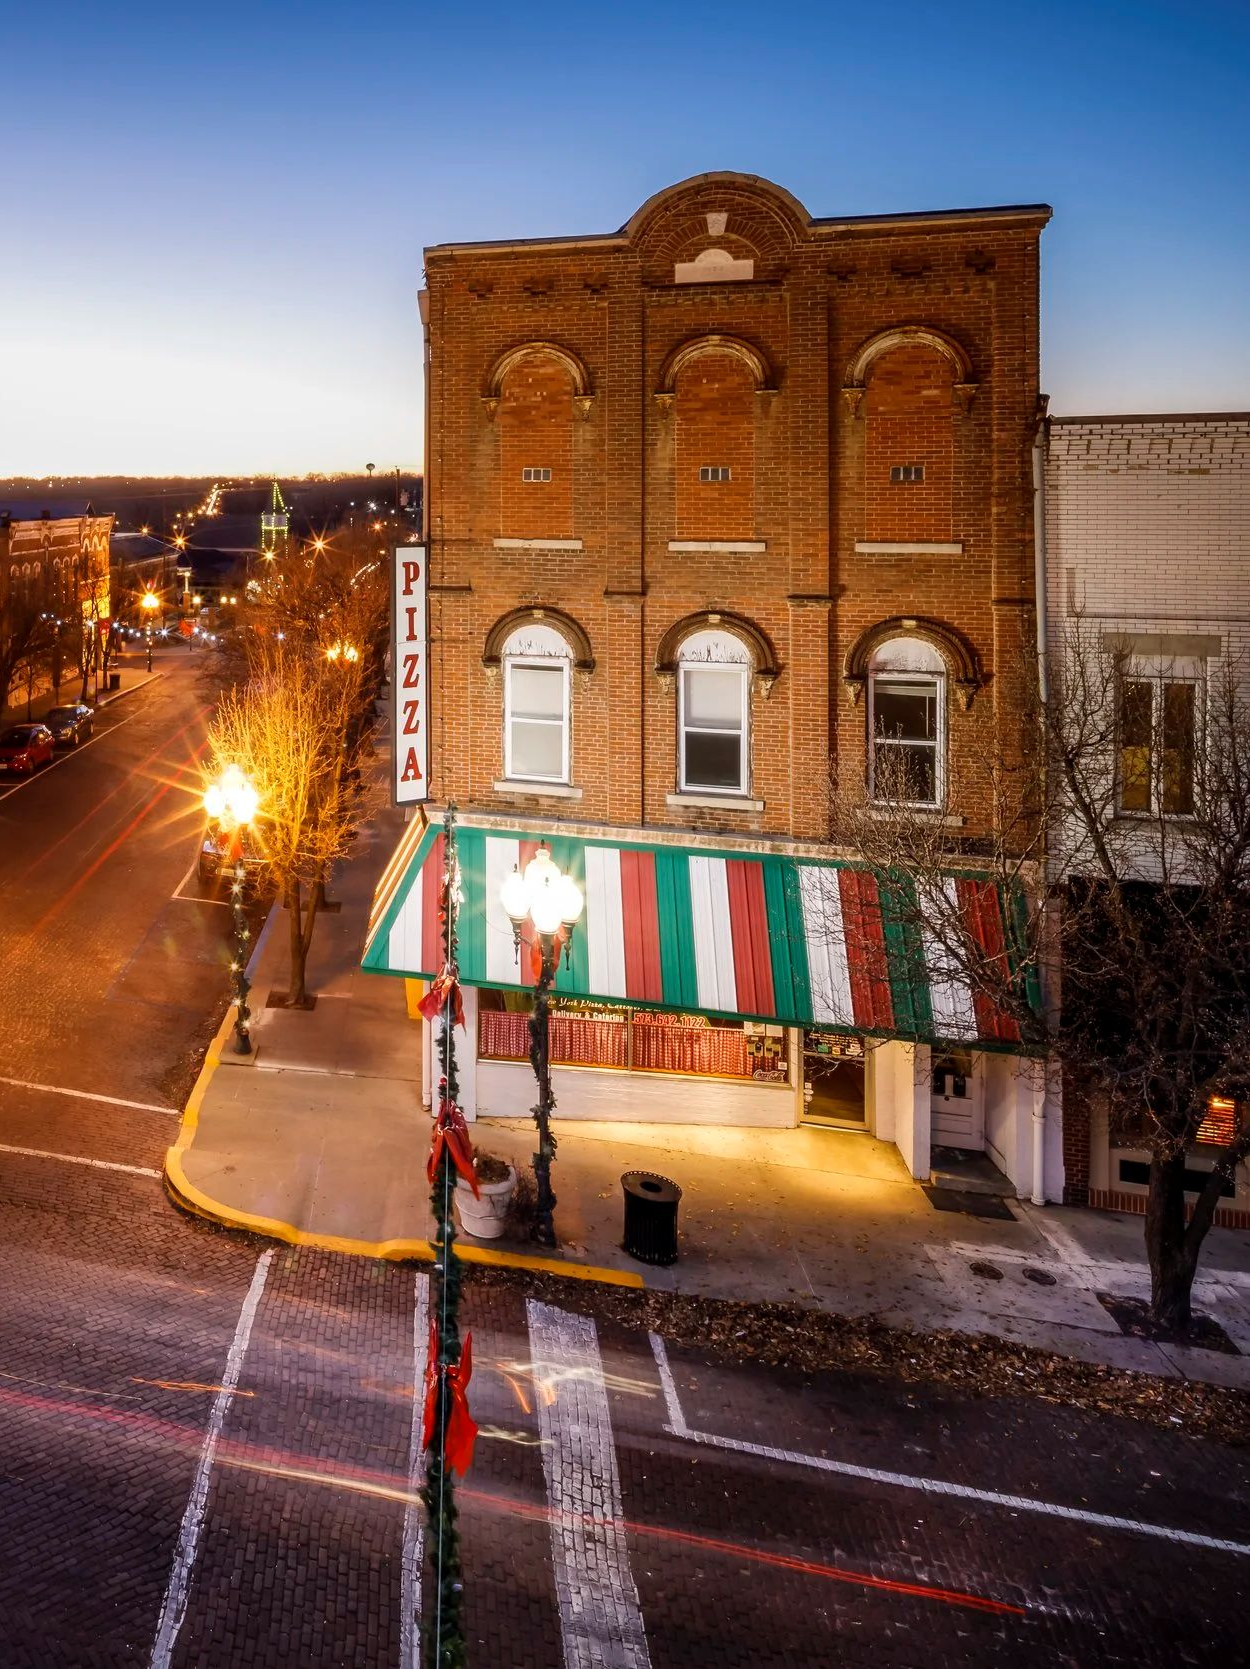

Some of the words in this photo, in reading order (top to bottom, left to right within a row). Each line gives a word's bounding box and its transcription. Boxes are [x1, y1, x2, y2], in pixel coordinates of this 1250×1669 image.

[401, 561, 423, 782] PIZZA
[559, 997, 579, 1007] York
[552, 1009, 582, 1020] Delivery
[584, 1011, 591, 1020] &
[593, 1012, 625, 1023] Catering
[633, 1012, 706, 1028] 573.642.1122
